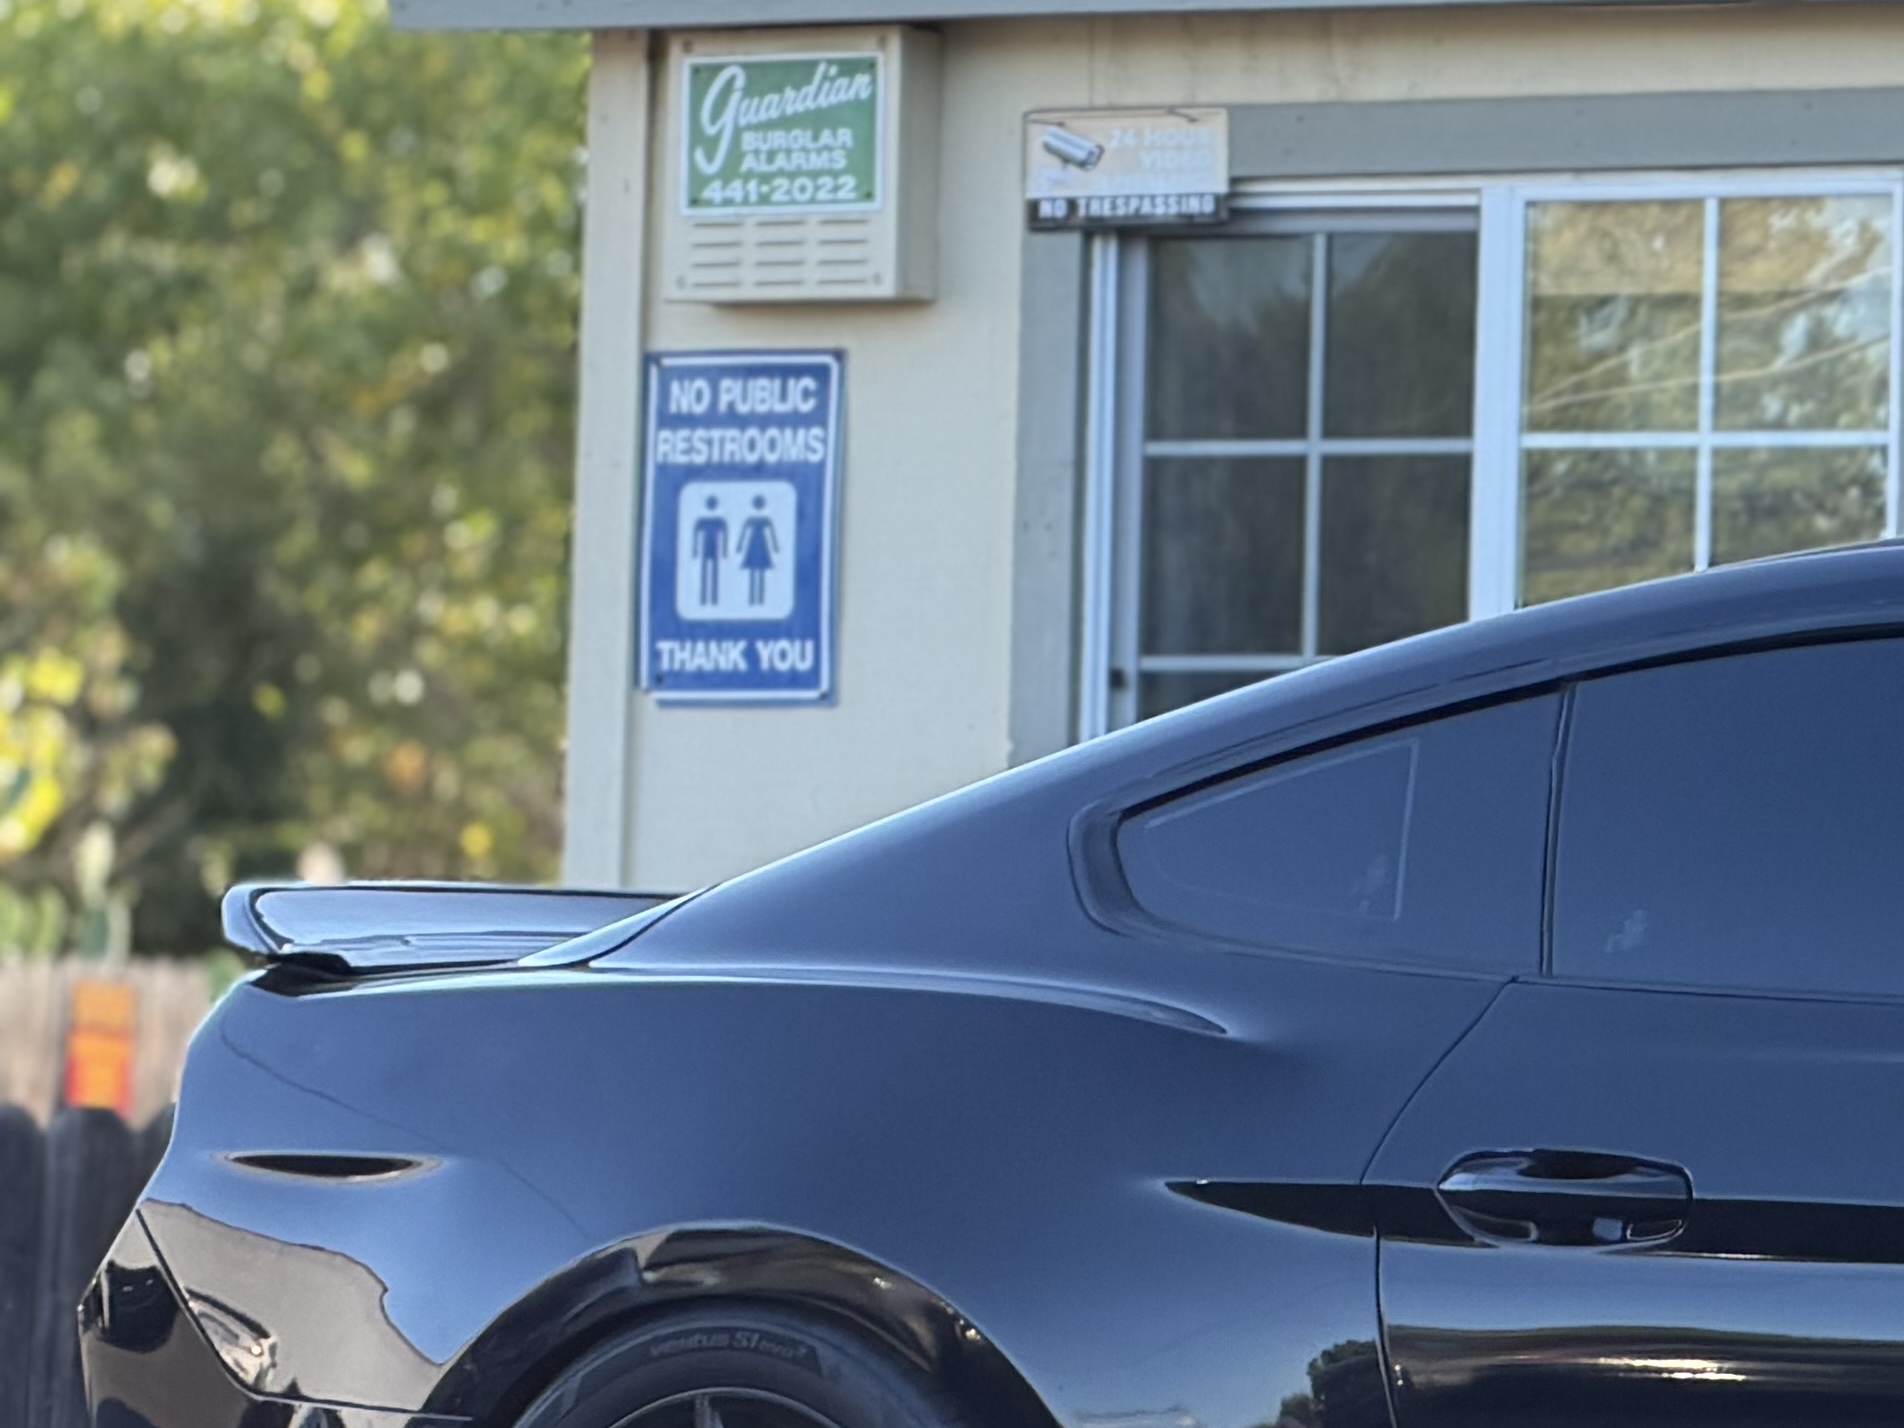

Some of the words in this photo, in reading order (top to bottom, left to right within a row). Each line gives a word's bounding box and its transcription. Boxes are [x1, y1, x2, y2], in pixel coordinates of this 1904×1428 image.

[694, 60, 873, 175] Guardian
[741, 128, 854, 151] BURGLAR
[740, 149, 847, 172] ALARMS
[702, 175, 856, 203] 441-2022
[1038, 199, 1068, 218] NO
[1078, 195, 1216, 217] TRESPASSING
[669, 378, 710, 414] NO
[718, 376, 817, 413] PUBLIC
[656, 427, 825, 464] RESTROOMS
[656, 640, 747, 671] THANK
[756, 639, 814, 671] YOU
